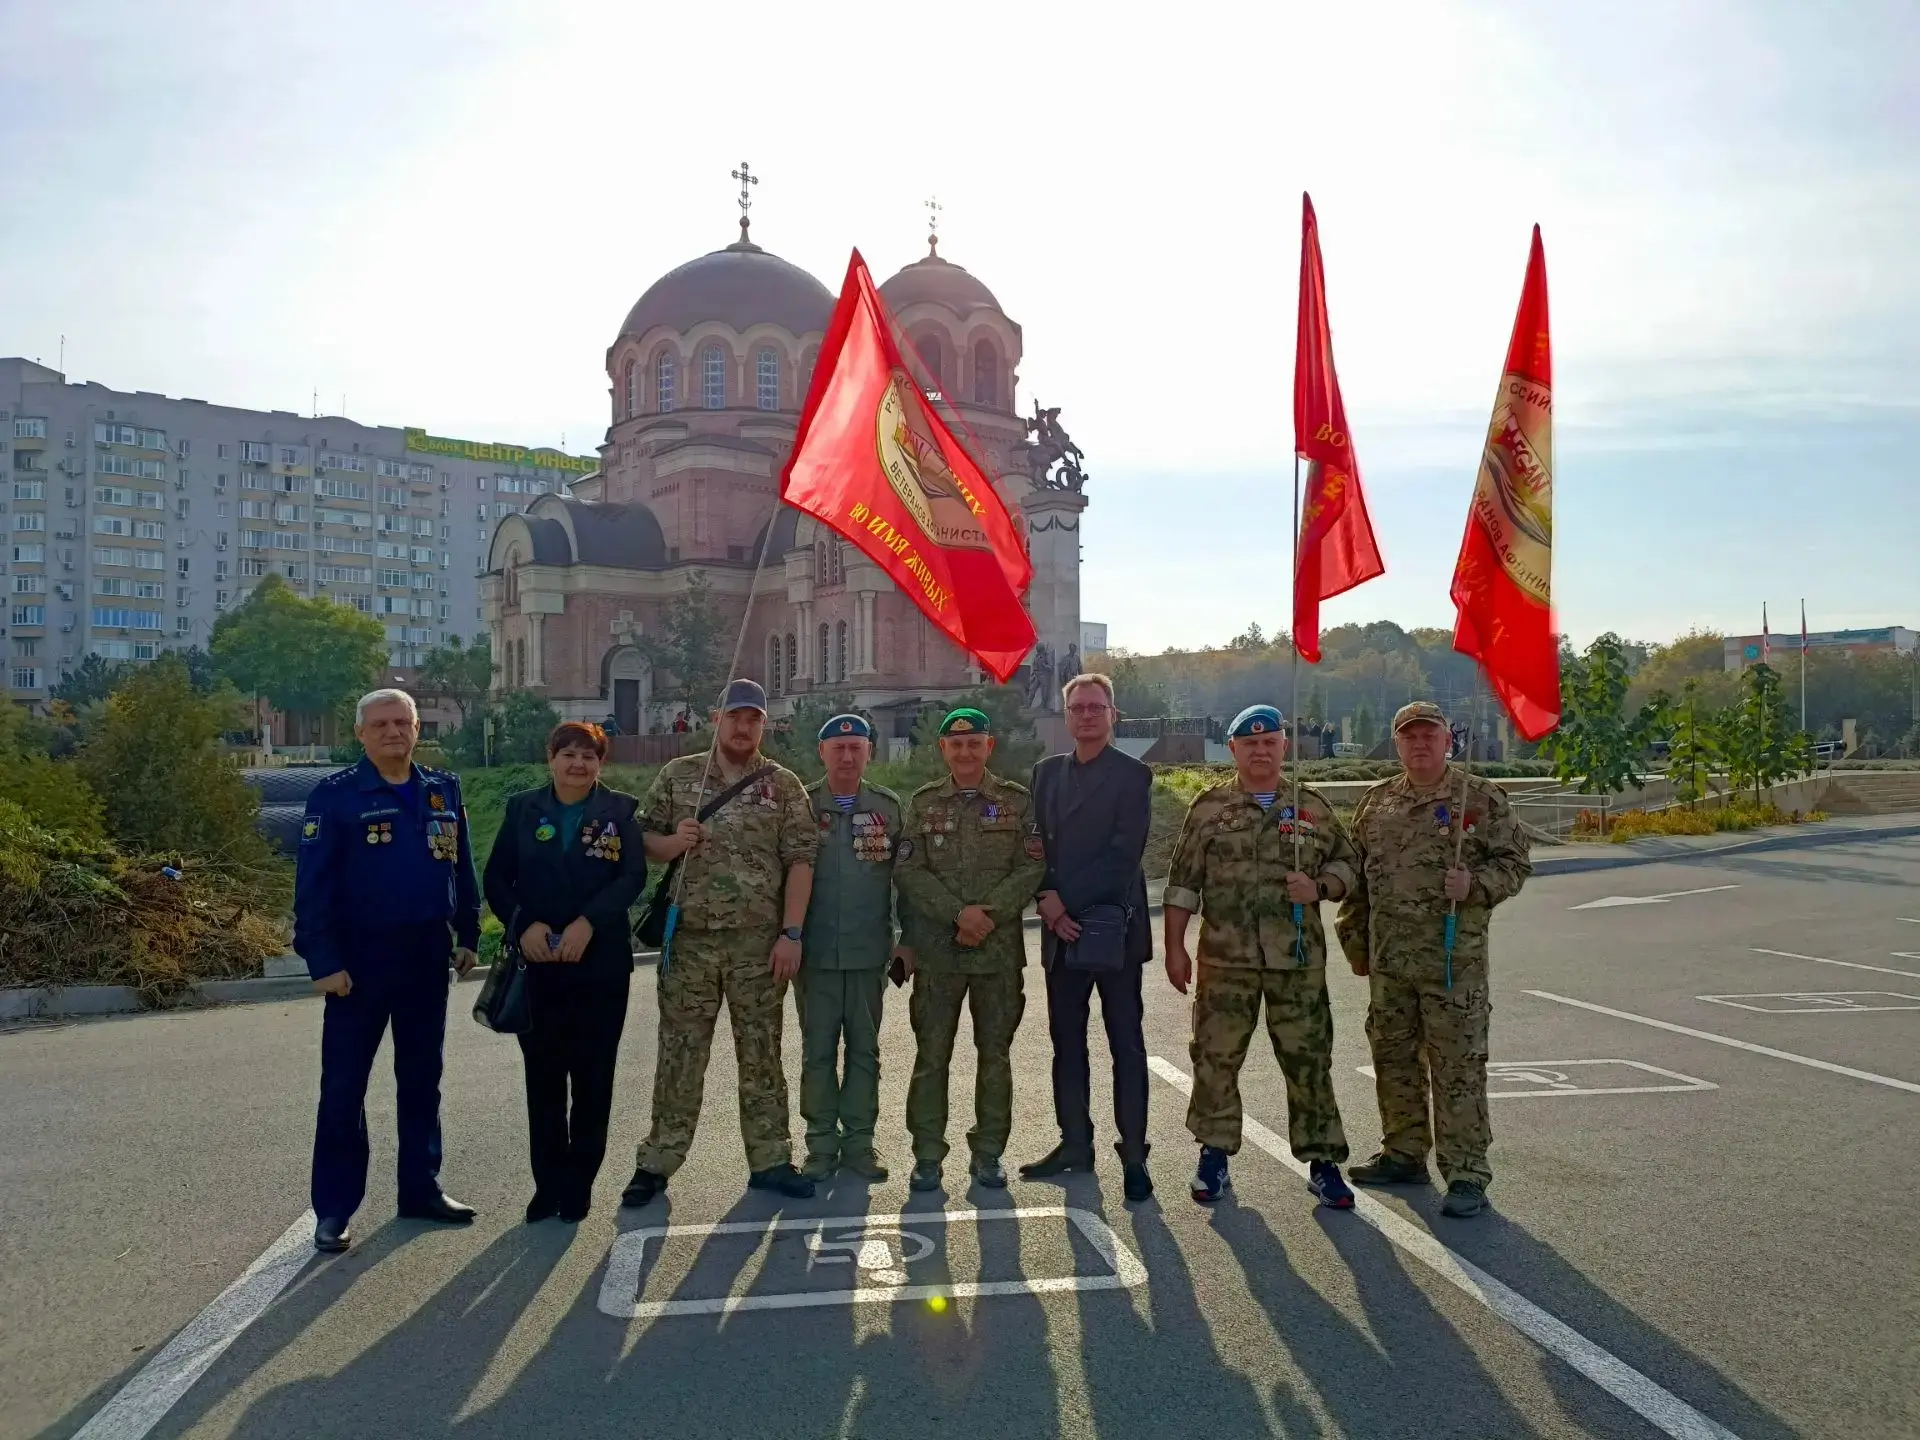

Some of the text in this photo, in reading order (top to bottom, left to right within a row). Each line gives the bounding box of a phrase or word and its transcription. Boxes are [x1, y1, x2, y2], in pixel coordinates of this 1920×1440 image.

[1315, 423, 1346, 447] ВО
[889, 460, 926, 524] ВЕТЕРАНОВ
[848, 502, 948, 612] ВО ИМЯ ЖИВЫХ
